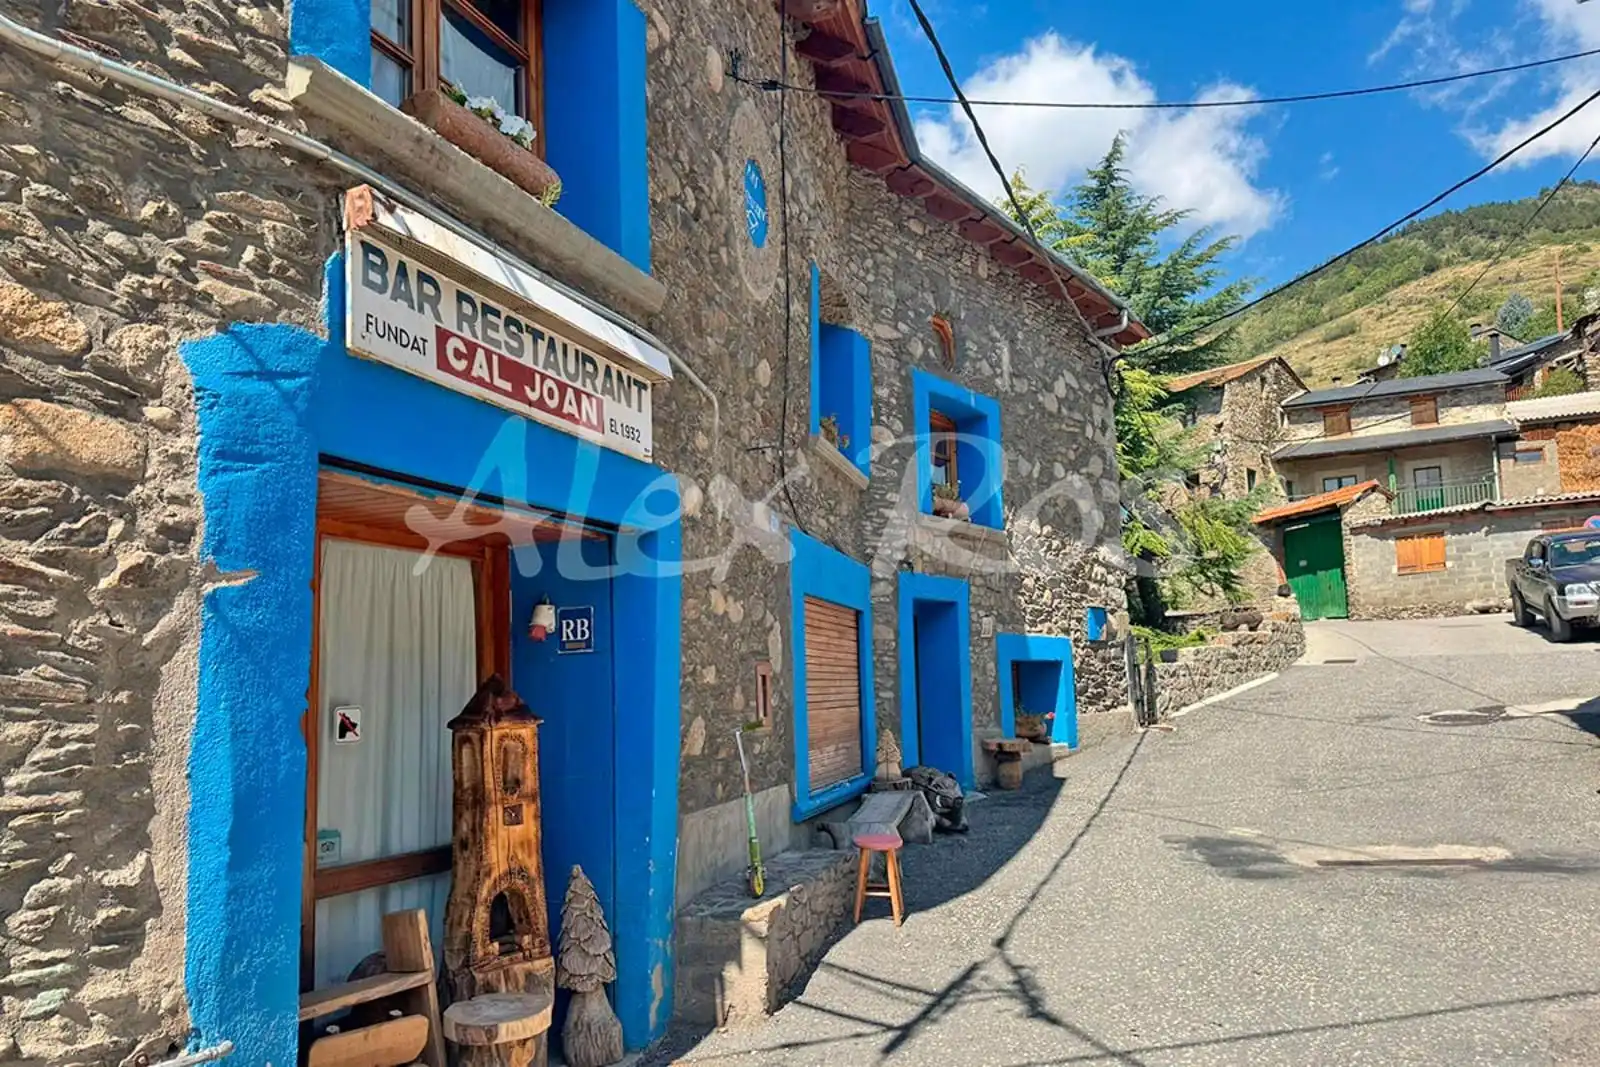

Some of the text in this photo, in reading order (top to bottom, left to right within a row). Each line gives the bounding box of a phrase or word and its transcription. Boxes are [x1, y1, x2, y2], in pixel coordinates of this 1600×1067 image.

[360, 241, 648, 413] BAR RESTAURANT
[365, 312, 428, 357] FUNDAT
[445, 336, 598, 427] CAL JOAN
[609, 417, 620, 436] EL
[561, 618, 590, 641] RB
